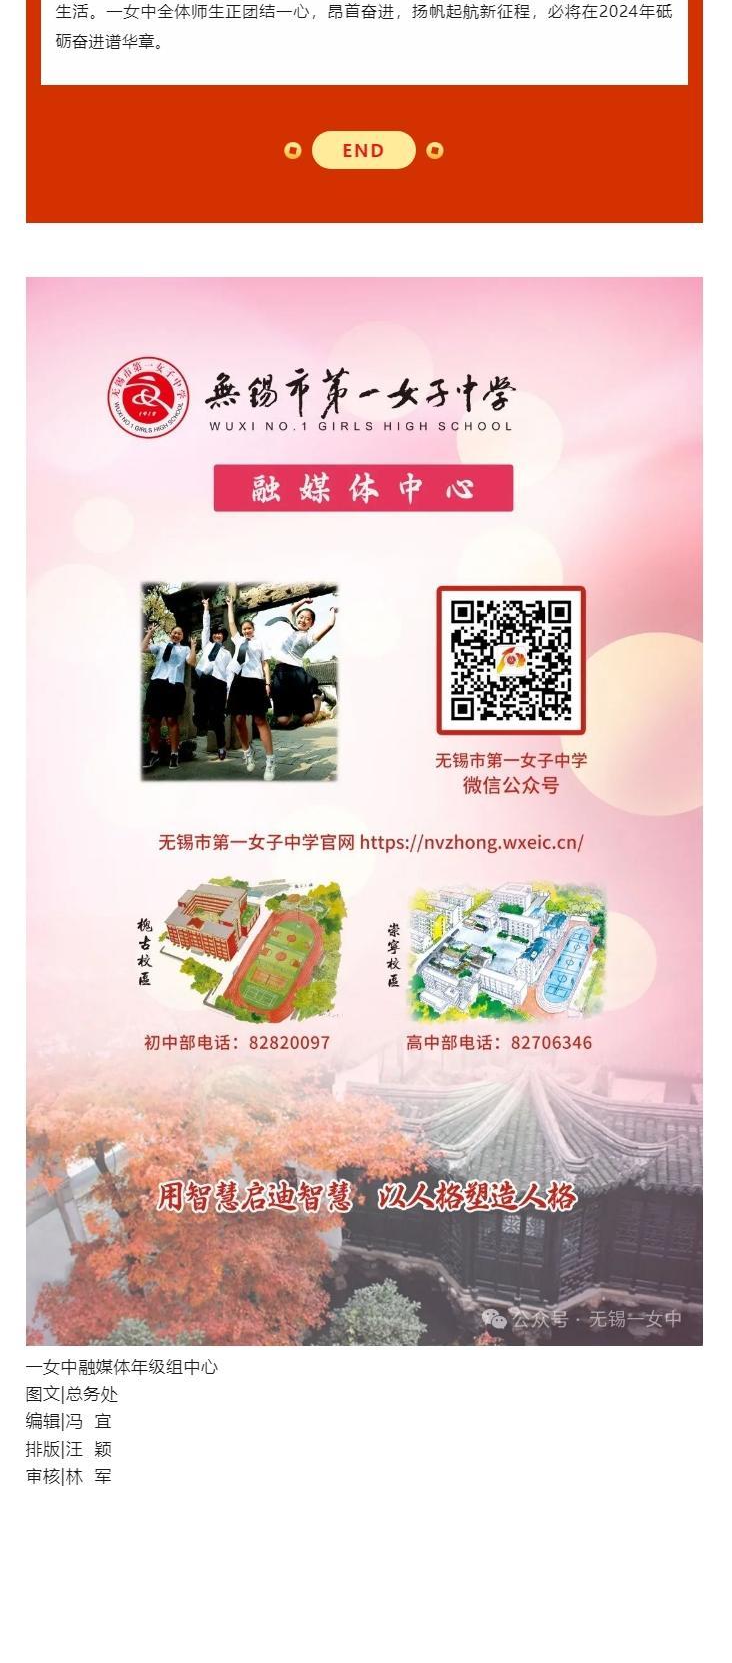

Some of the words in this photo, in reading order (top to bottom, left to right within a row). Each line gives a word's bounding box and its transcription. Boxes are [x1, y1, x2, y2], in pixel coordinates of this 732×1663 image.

[56, 3, 672, 19] 生活。一女中全体师生正团结一心，昂首奋进，扬帆起航新征程，必将在2024年砥
[56, 33, 160, 49] 砺奋进谱华章。
[343, 144, 383, 157] END
[209, 421, 256, 431] WUXI
[265, 421, 308, 431] NO.1
[318, 421, 374, 431] GIRLS
[383, 421, 429, 431] HIGH
[438, 421, 513, 431] SCHOOL
[252, 472, 475, 504] 融媒体中心
[436, 752, 587, 769] 无锡市第一女子中学
[463, 776, 559, 794] 微信公众号
[159, 834, 354, 850] 无锡市第一女子中学官网
[361, 834, 584, 853] https://nvzhong.wxeic.cn/
[144, 1034, 330, 1050] 初中部电话：82820097
[407, 1034, 592, 1050] 高中部电话：82706346
[157, 1181, 353, 1213] 用智慧启迪智慧
[377, 1181, 578, 1212] 以人格塑造人格
[26, 1359, 218, 1375] 一女中融媒体年级组中心
[26, 1385, 118, 1404] 图文|总务处
[26, 1412, 82, 1431] 编辑|冯
[95, 1413, 111, 1428] 宜
[26, 1441, 83, 1459] 排版|汪
[95, 1441, 111, 1457] 颖
[26, 1468, 83, 1486] 审核|林
[95, 1469, 111, 1484] 军
